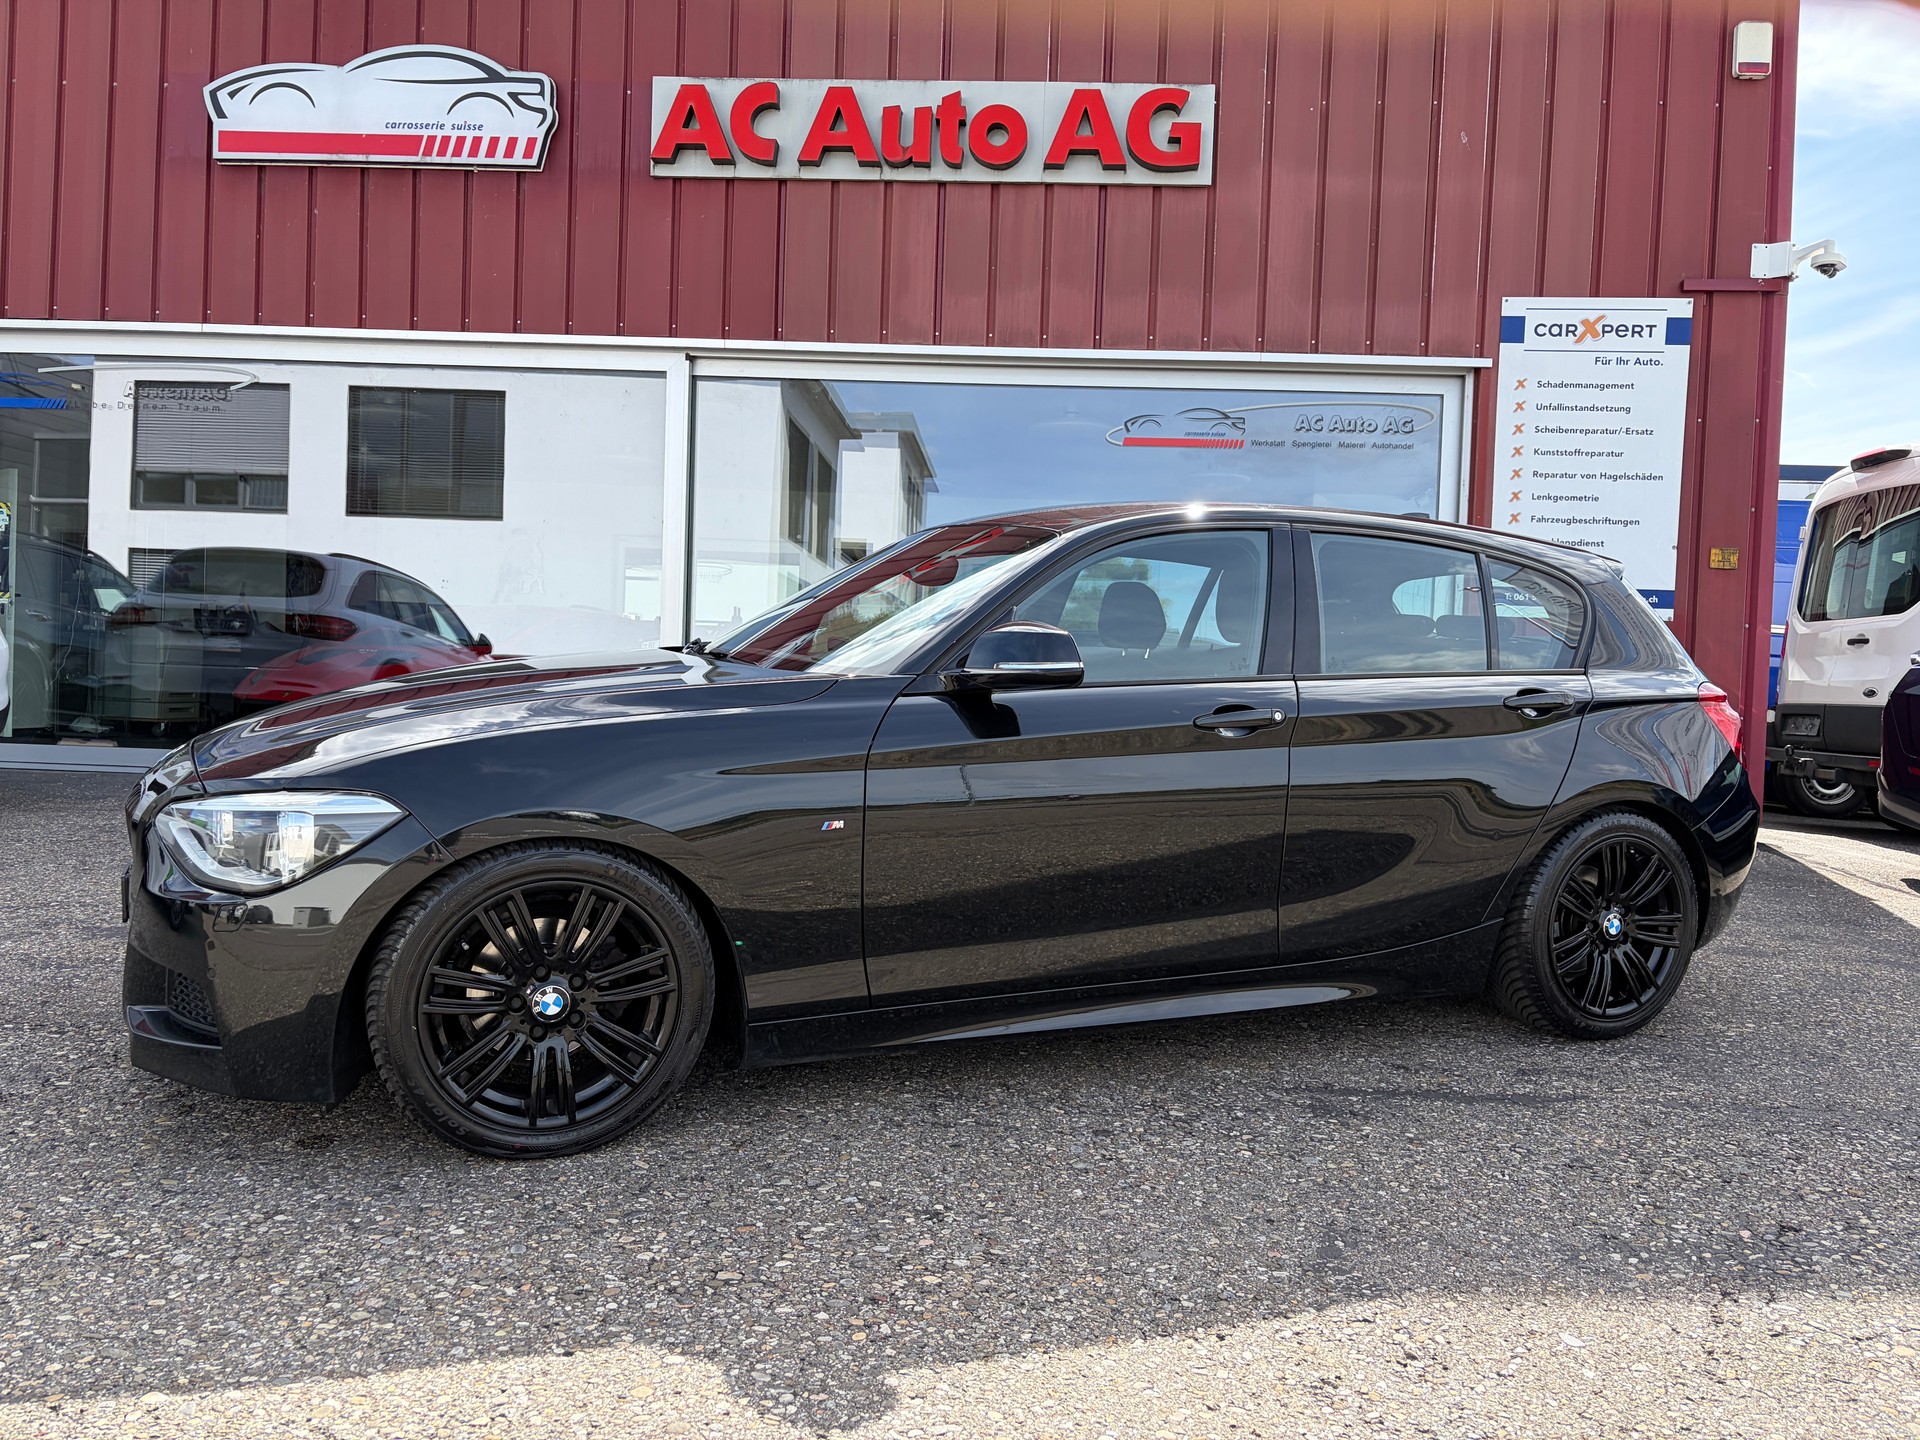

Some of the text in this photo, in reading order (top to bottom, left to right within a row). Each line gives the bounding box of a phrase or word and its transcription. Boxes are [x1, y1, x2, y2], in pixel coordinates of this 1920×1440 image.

[384, 119, 484, 132] carrosserie suisse
[651, 82, 1203, 172] AC Auto AG
[1594, 356, 1664, 367] Für Ihr Auto.
[1536, 380, 1635, 392] Schadenmanagement
[1535, 403, 1632, 415] Unfallinstandsetzung
[1294, 413, 1416, 435] AC Auto AG
[1534, 425, 1655, 437] Scheibenreparatur/-Ersatz
[1251, 439, 1415, 450] Werkstatt Spenglerei Malerei Autohandel
[1533, 448, 1625, 460] Kunststoffreparatur
[1532, 470, 1578, 481] Reparatur
[1599, 471, 1664, 482] Hagelschäden
[1531, 493, 1600, 503] Lenkgeometrie
[1530, 515, 1641, 528] Fahrzeugbeschriftungen
[1513, 592, 1530, 601] 061
